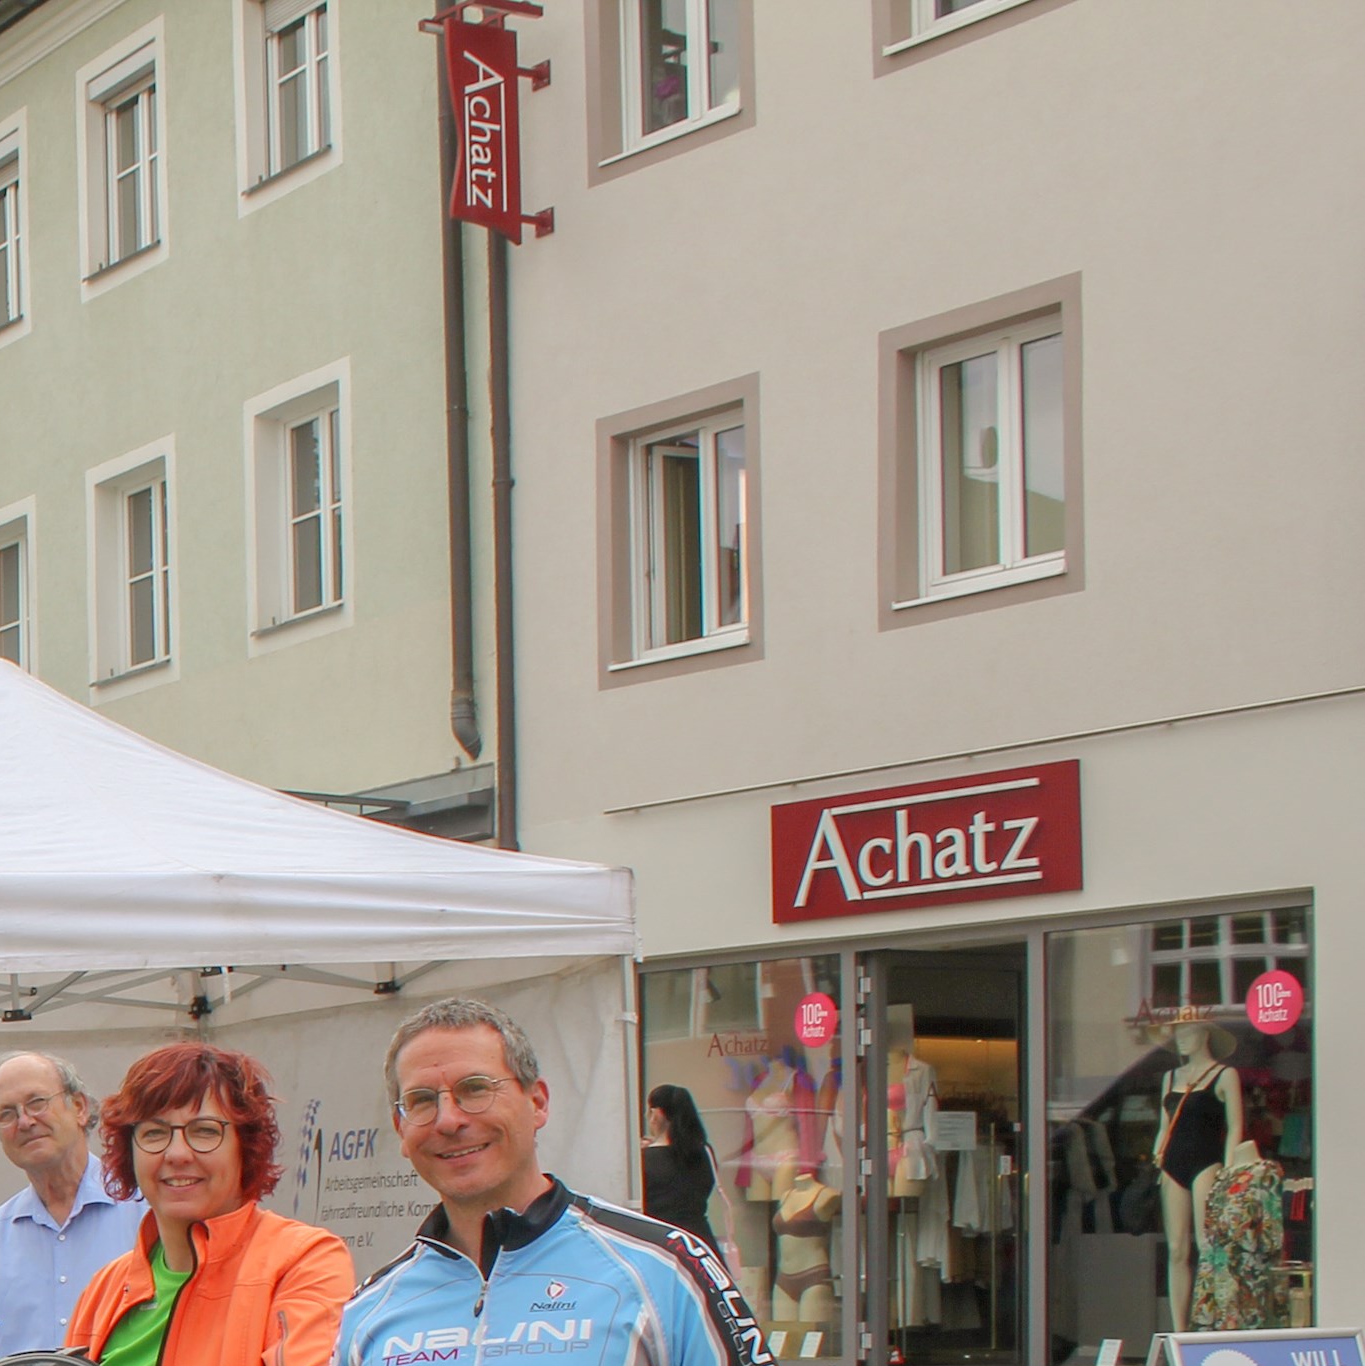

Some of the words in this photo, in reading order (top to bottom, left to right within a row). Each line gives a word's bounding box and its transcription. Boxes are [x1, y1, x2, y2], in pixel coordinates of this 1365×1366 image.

[463, 50, 505, 209] Achatz
[793, 807, 1040, 908] Achatz
[1258, 1008, 1288, 1023] Achatz
[707, 1032, 769, 1058] Achatz
[328, 1128, 379, 1162] AGFK
[324, 1169, 418, 1193] Arbeitsgemeinschaft
[321, 1201, 405, 1221] fahrradfreundliche
[530, 1300, 577, 1311] Nalini
[484, 1341, 590, 1358] GROUP
